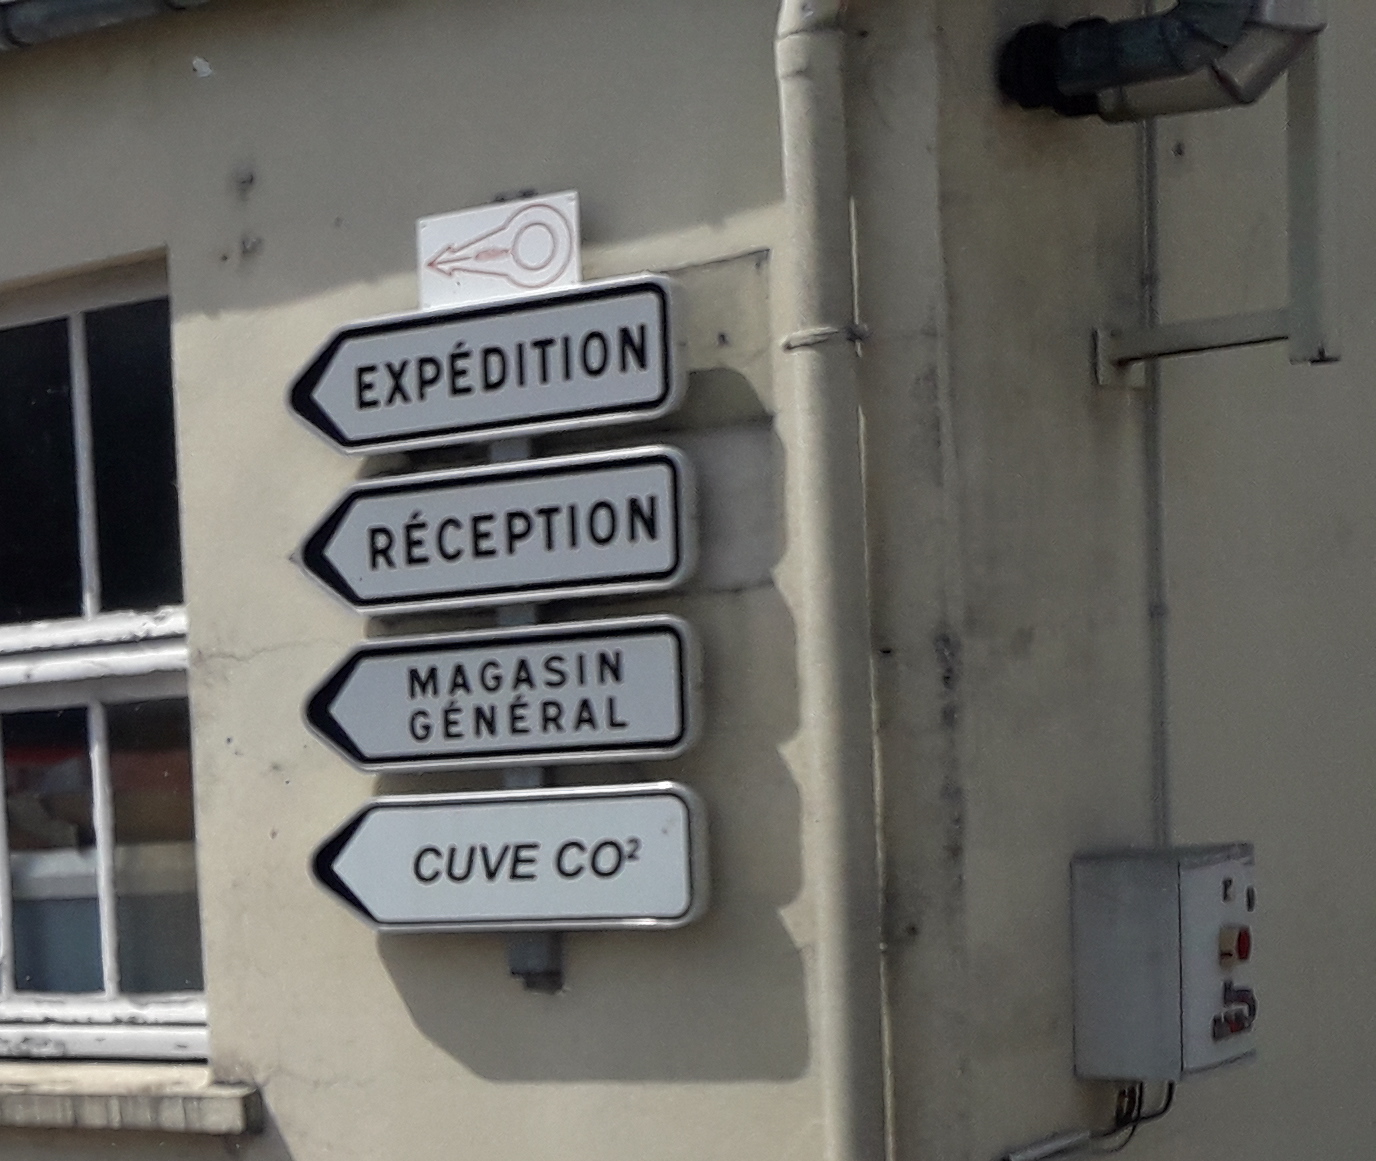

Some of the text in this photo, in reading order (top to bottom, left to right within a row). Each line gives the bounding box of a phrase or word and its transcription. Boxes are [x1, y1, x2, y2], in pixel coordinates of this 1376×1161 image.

[356, 324, 648, 410] EXPÉDITION
[368, 495, 658, 571] RÉCEPTION
[408, 650, 625, 699] MAGASIN
[408, 696, 629, 742] GÉNÉRAL
[413, 842, 540, 883] CUVE
